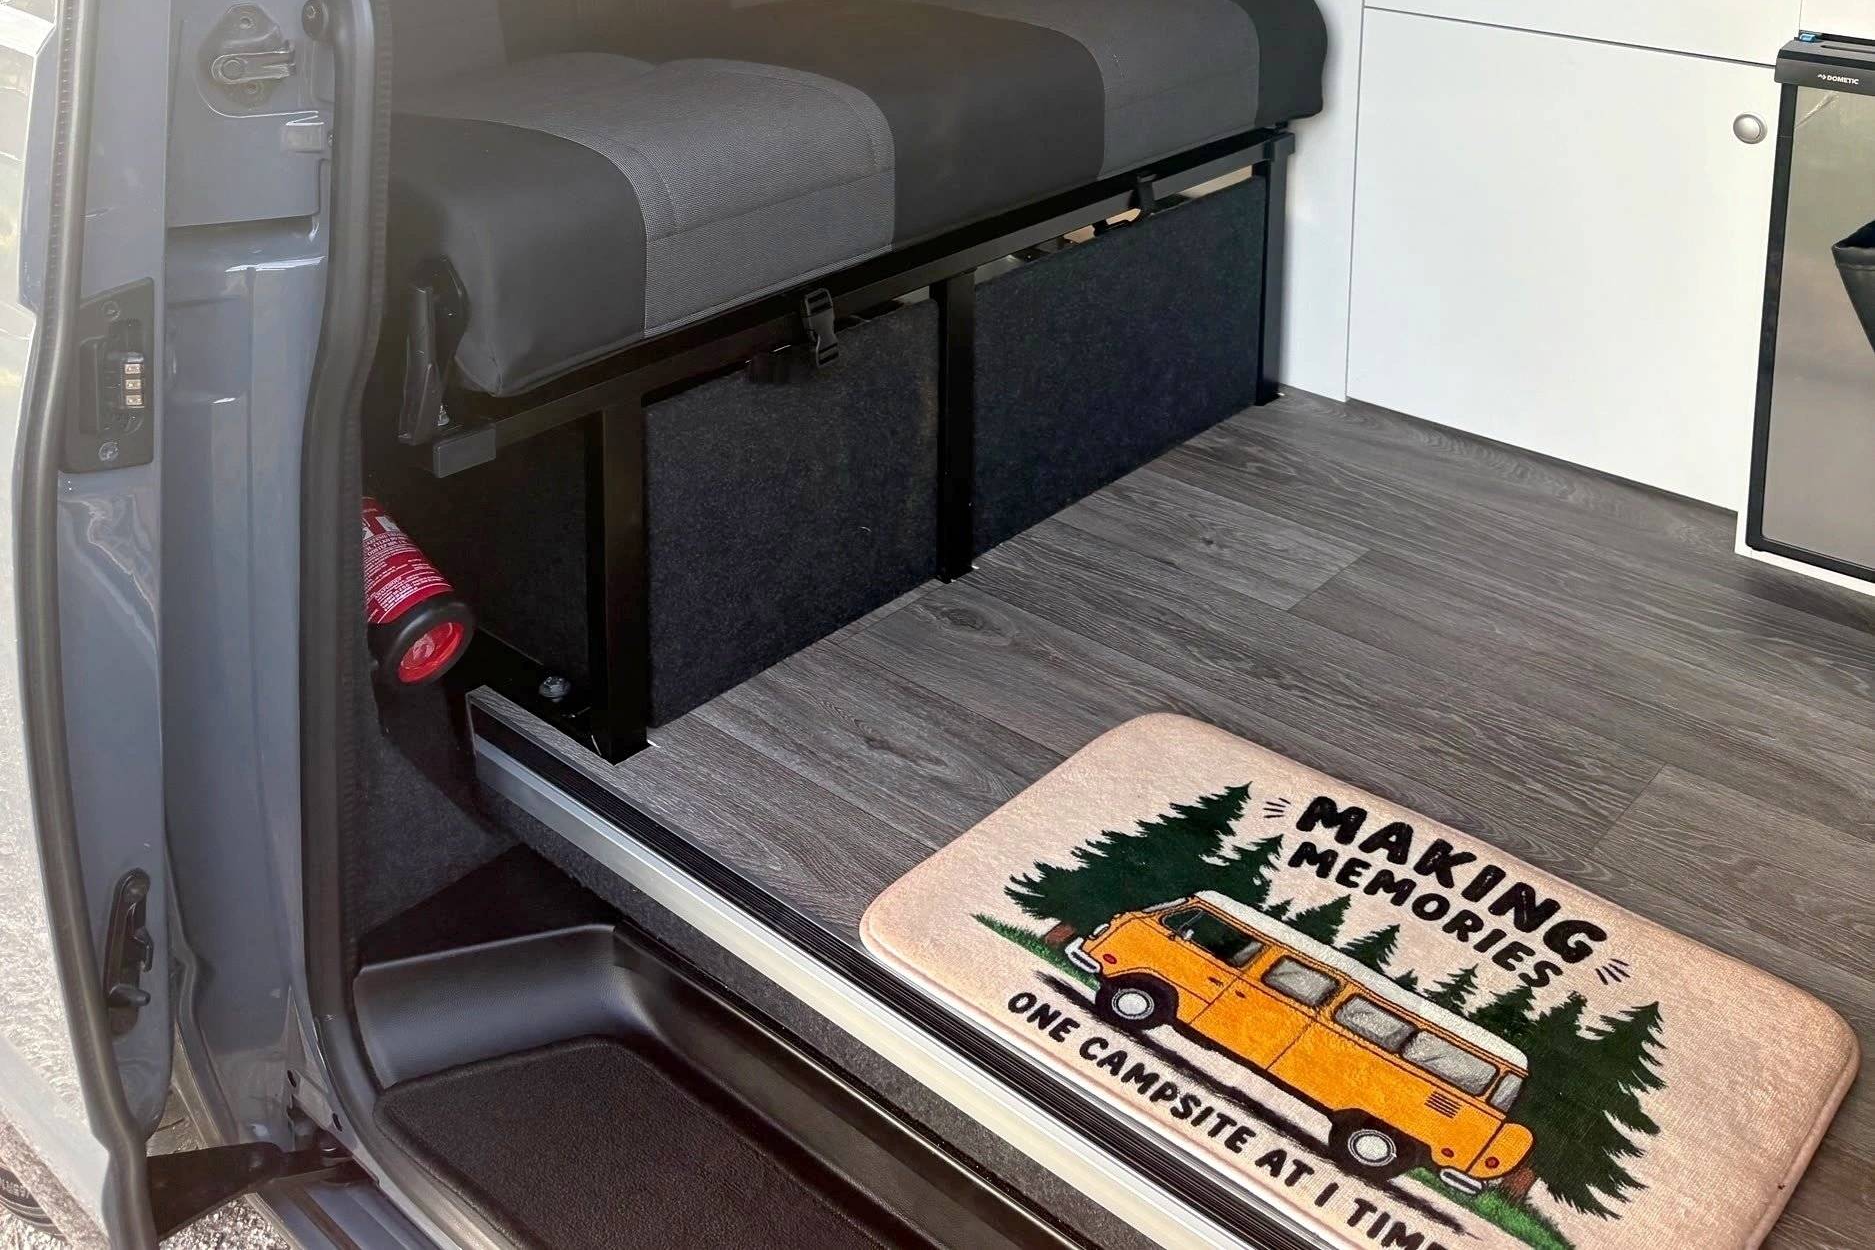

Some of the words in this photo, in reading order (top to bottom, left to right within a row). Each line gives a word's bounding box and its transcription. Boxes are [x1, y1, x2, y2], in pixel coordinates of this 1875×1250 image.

[1827, 75, 1859, 85] DOMETIC
[1287, 841, 1563, 988] MEMORIES
[1296, 796, 1607, 964] MAKING
[1007, 992, 1080, 1043] ONE
[1079, 1036, 1257, 1154] CAMPSITE
[1254, 1148, 1316, 1188] AT
[1345, 1197, 1448, 1250] TIM
